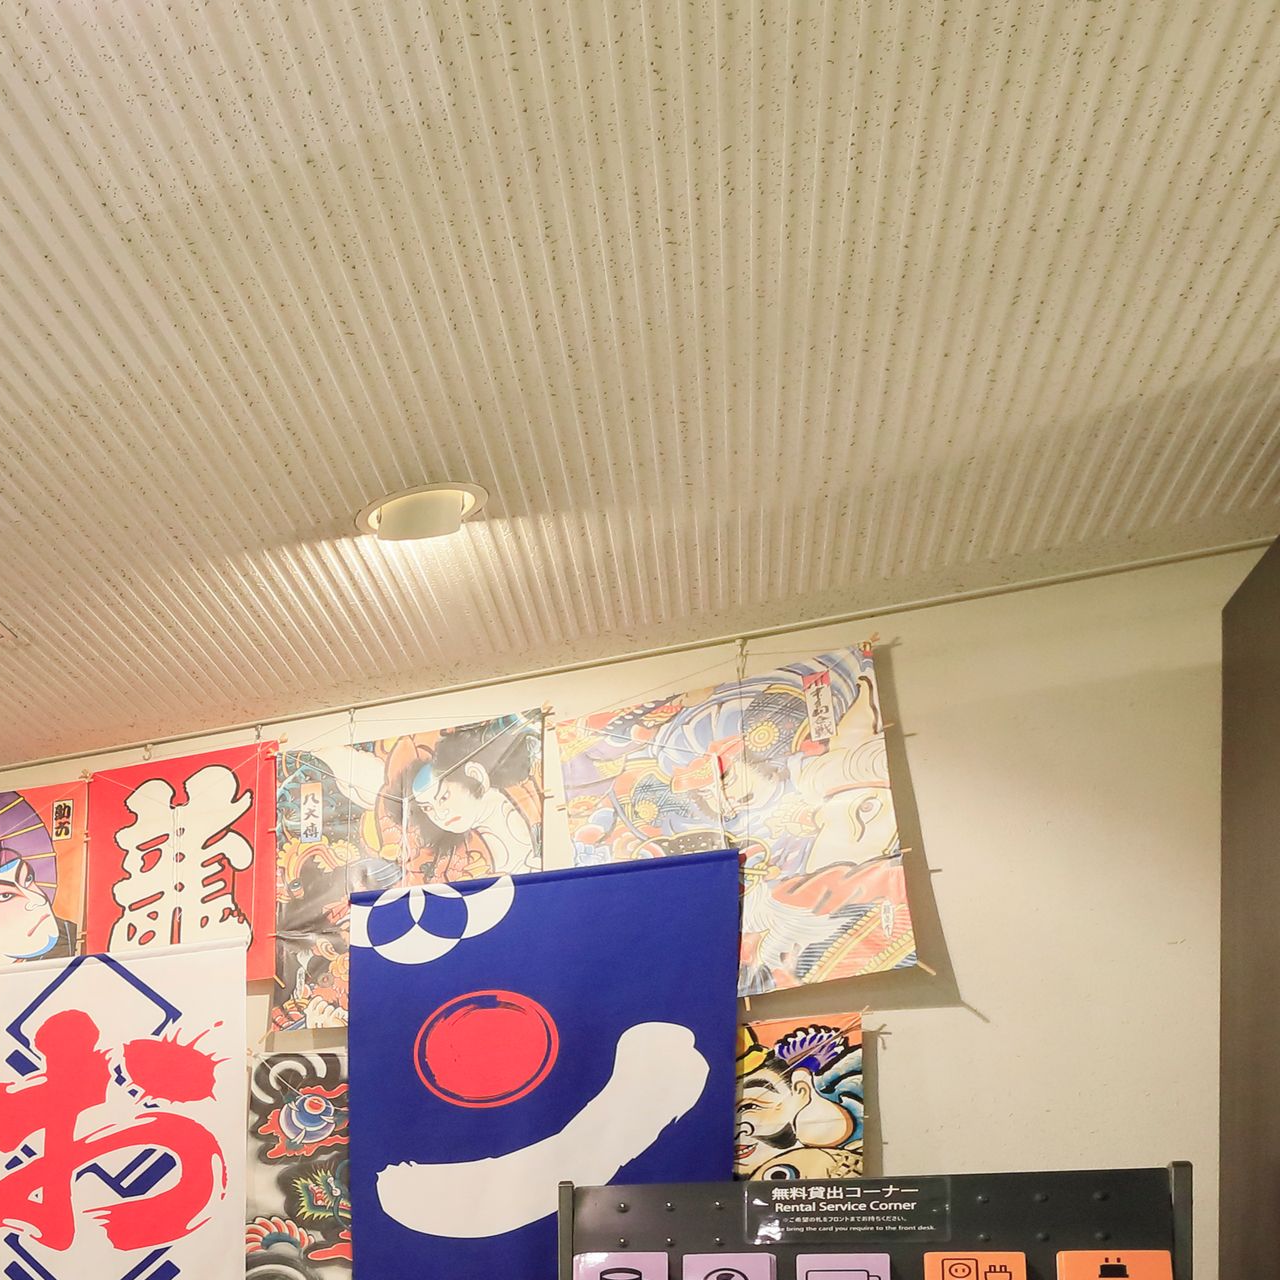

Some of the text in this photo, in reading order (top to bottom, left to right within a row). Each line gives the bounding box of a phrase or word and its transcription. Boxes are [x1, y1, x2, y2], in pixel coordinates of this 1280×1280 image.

[771, 1184, 919, 1200] 無料貸出コーナー
[775, 1200, 917, 1212] Rental Service Corner
